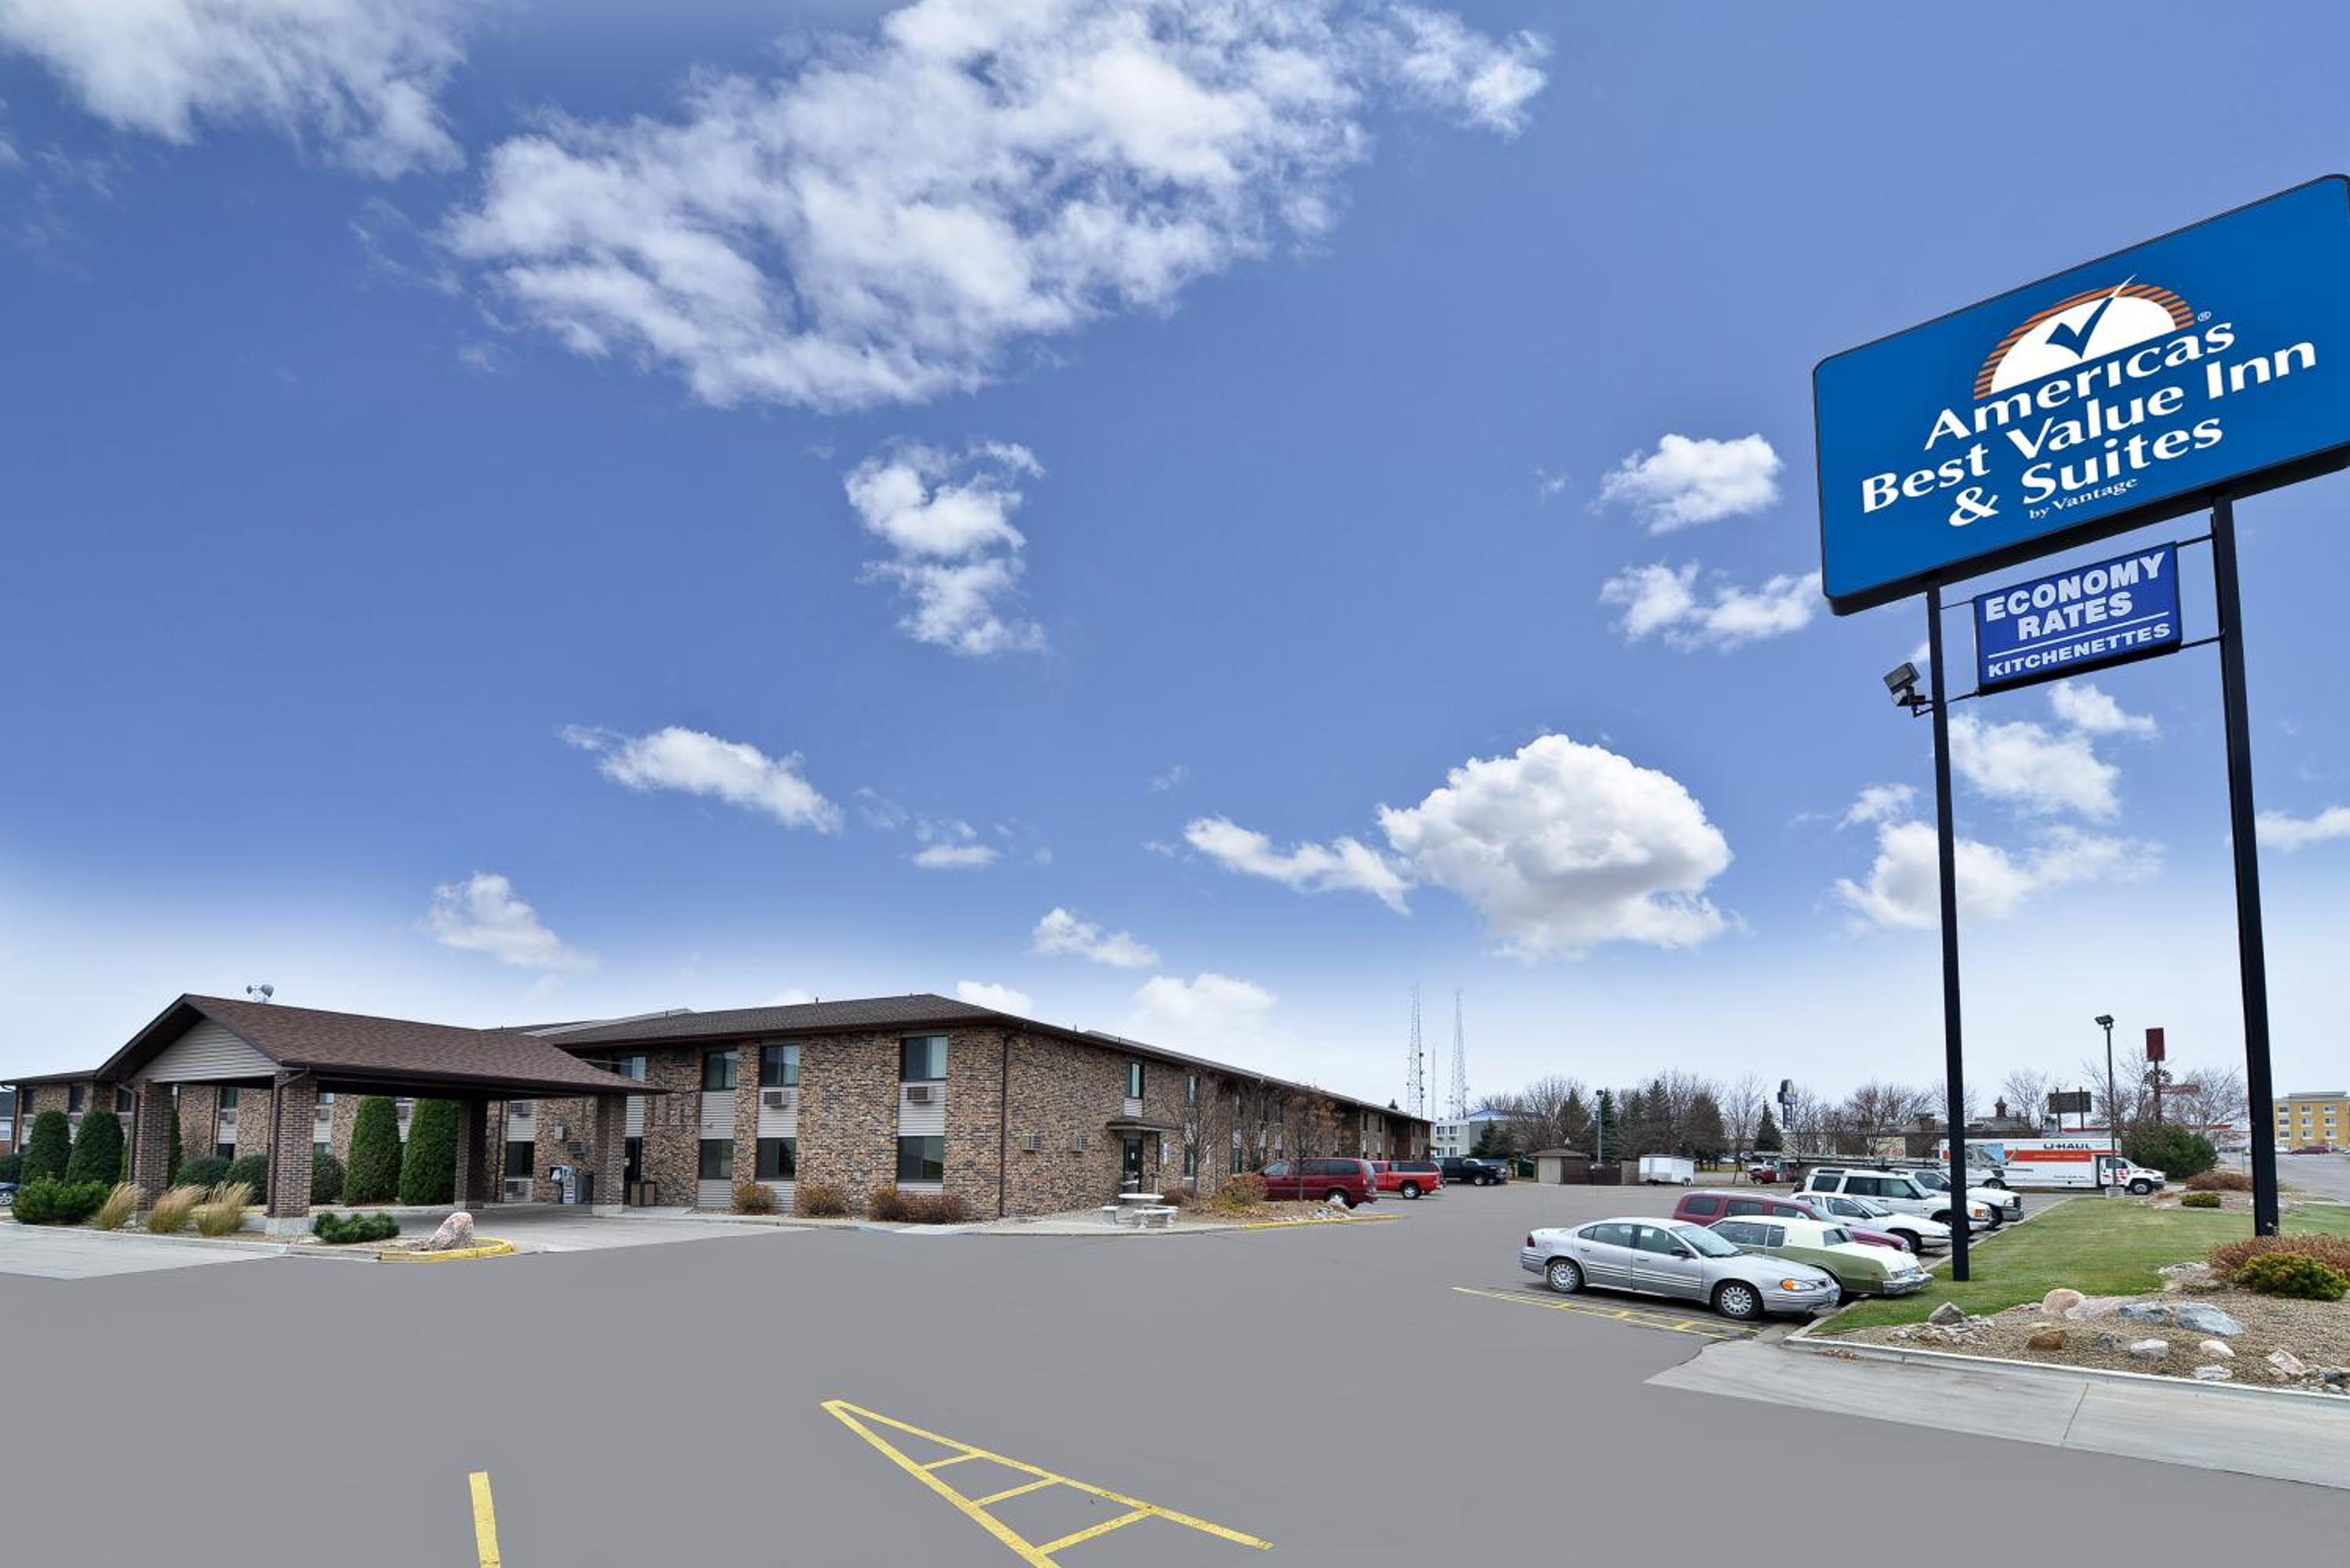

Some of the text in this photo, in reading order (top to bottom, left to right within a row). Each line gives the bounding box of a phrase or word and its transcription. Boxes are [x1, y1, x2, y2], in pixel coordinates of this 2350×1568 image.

[1924, 322, 2235, 450] Americas
[1862, 342, 2316, 513] Best Value Inn
[1948, 417, 2223, 527] & Suites
[2030, 479, 2138, 519] by Vantage
[1985, 551, 2166, 622] ECONOMY
[2018, 591, 2133, 641] RATES
[1988, 623, 2171, 677] KITCHENETTES
